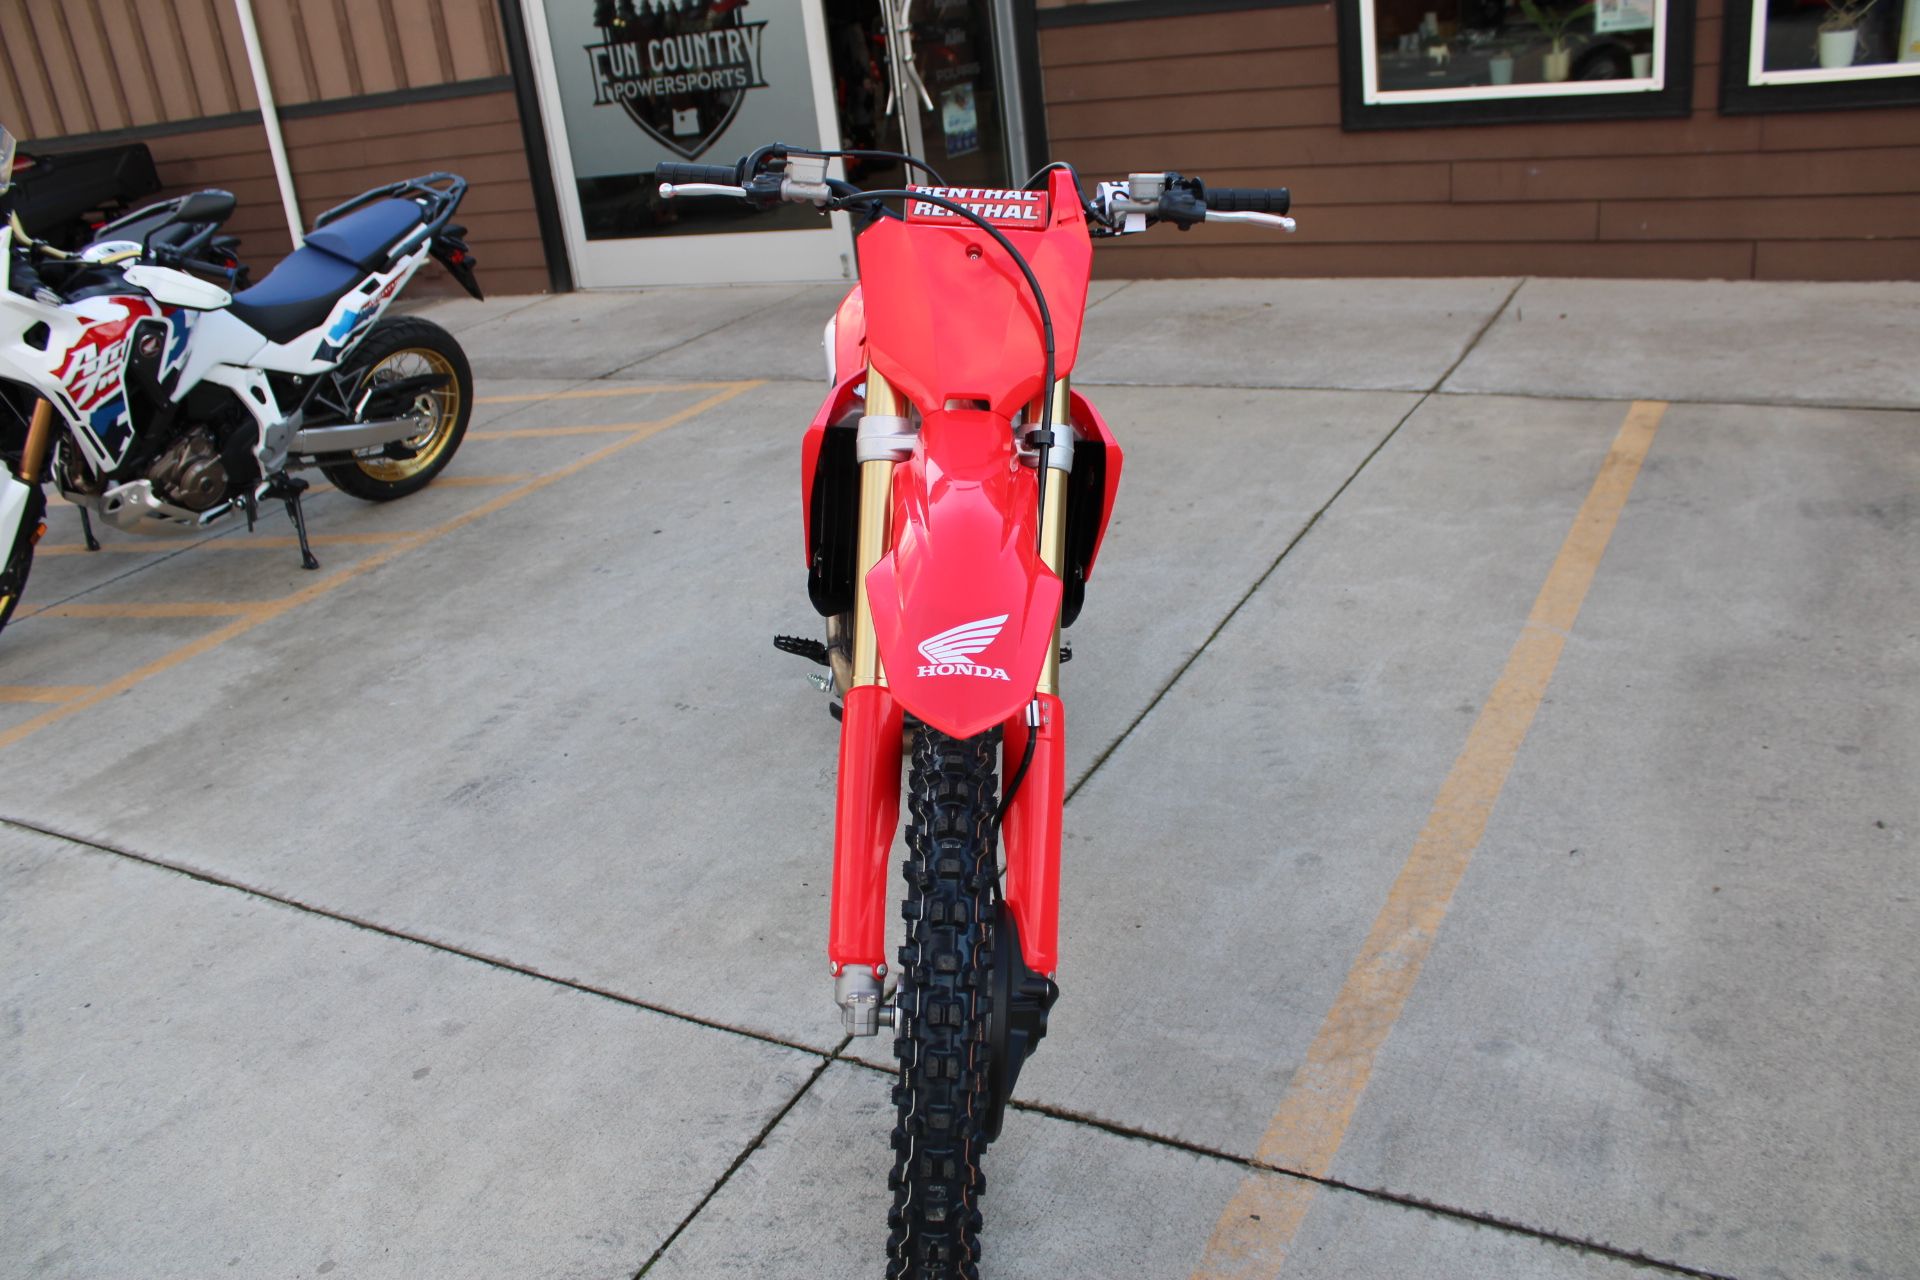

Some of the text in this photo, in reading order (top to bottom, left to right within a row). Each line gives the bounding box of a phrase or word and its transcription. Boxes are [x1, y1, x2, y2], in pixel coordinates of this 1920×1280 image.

[590, 26, 760, 103] FUN COUNTRY
[615, 68, 747, 99] POWERSPORTS
[915, 186, 1039, 200] RENTHAL
[917, 663, 1011, 680] HONDA
